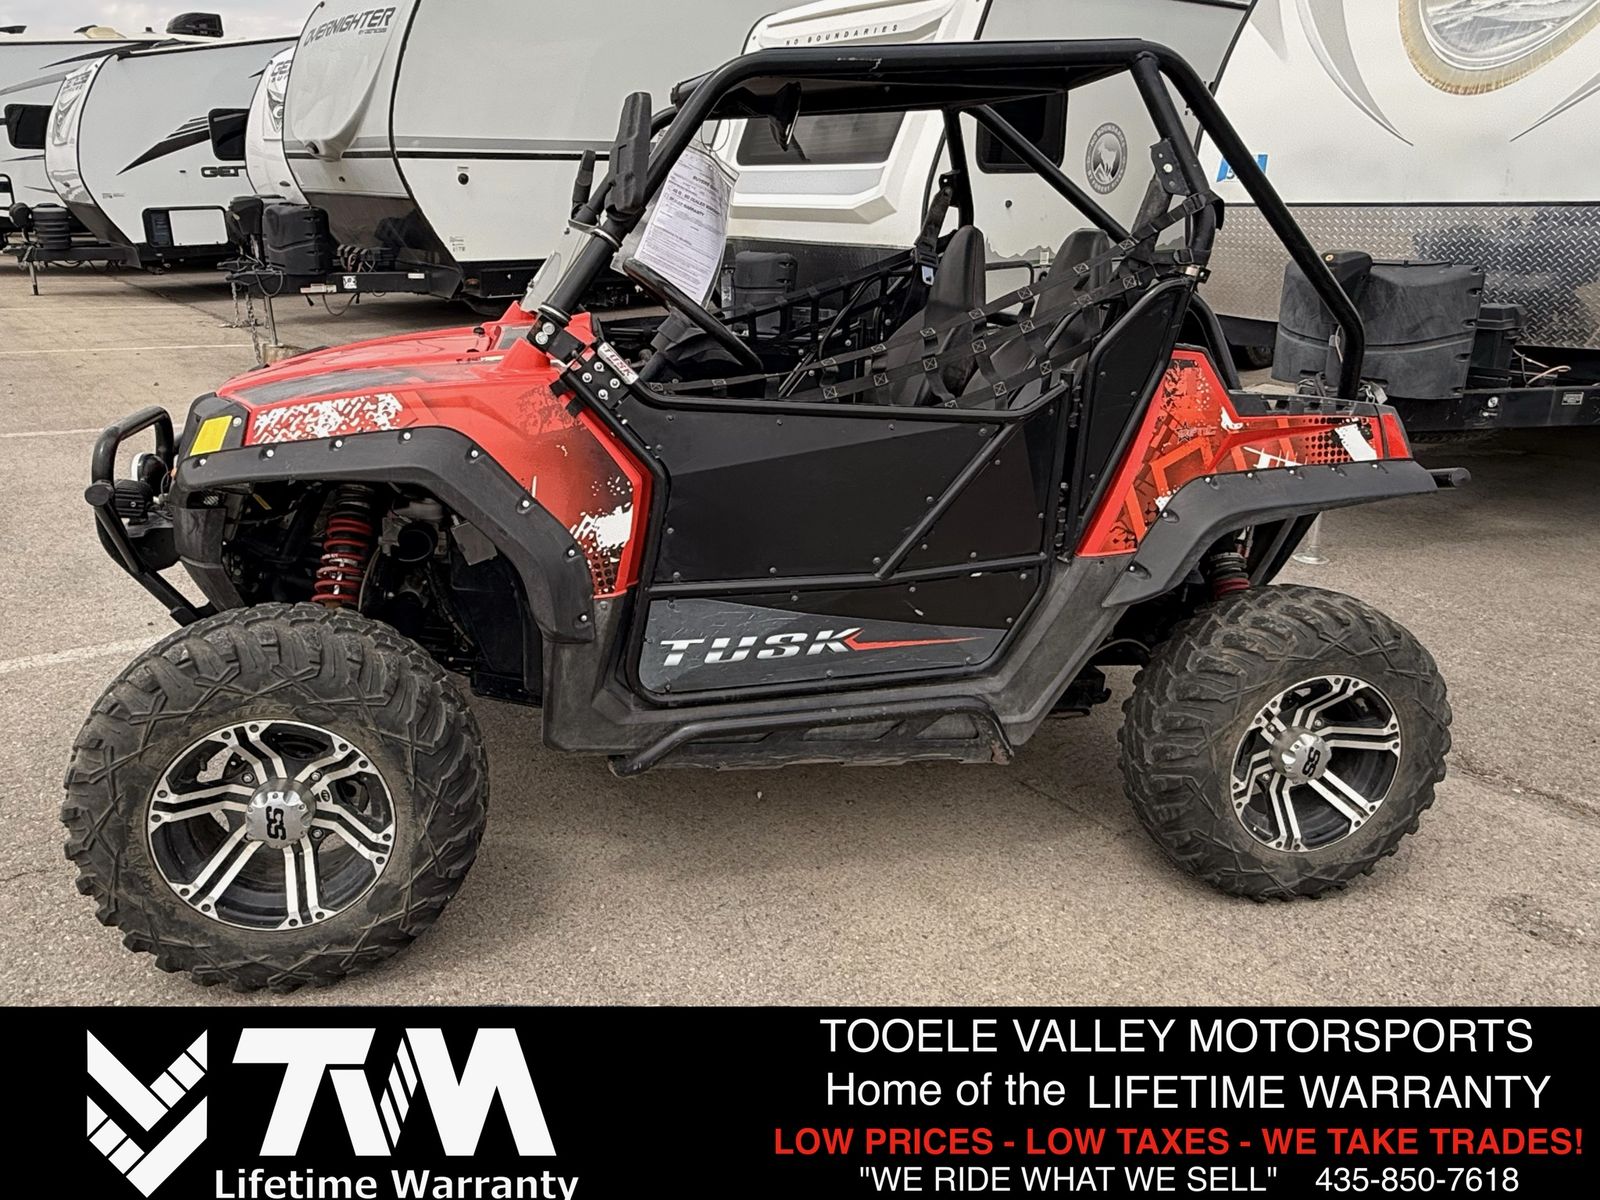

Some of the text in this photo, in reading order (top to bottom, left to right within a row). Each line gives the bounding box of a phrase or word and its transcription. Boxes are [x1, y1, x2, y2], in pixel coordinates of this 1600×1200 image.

[303, 7, 396, 47] OVERNIGHTER
[786, 24, 898, 46] NO BOUNDARIES
[605, 348, 634, 377] TUSK
[660, 628, 861, 667] TUSK
